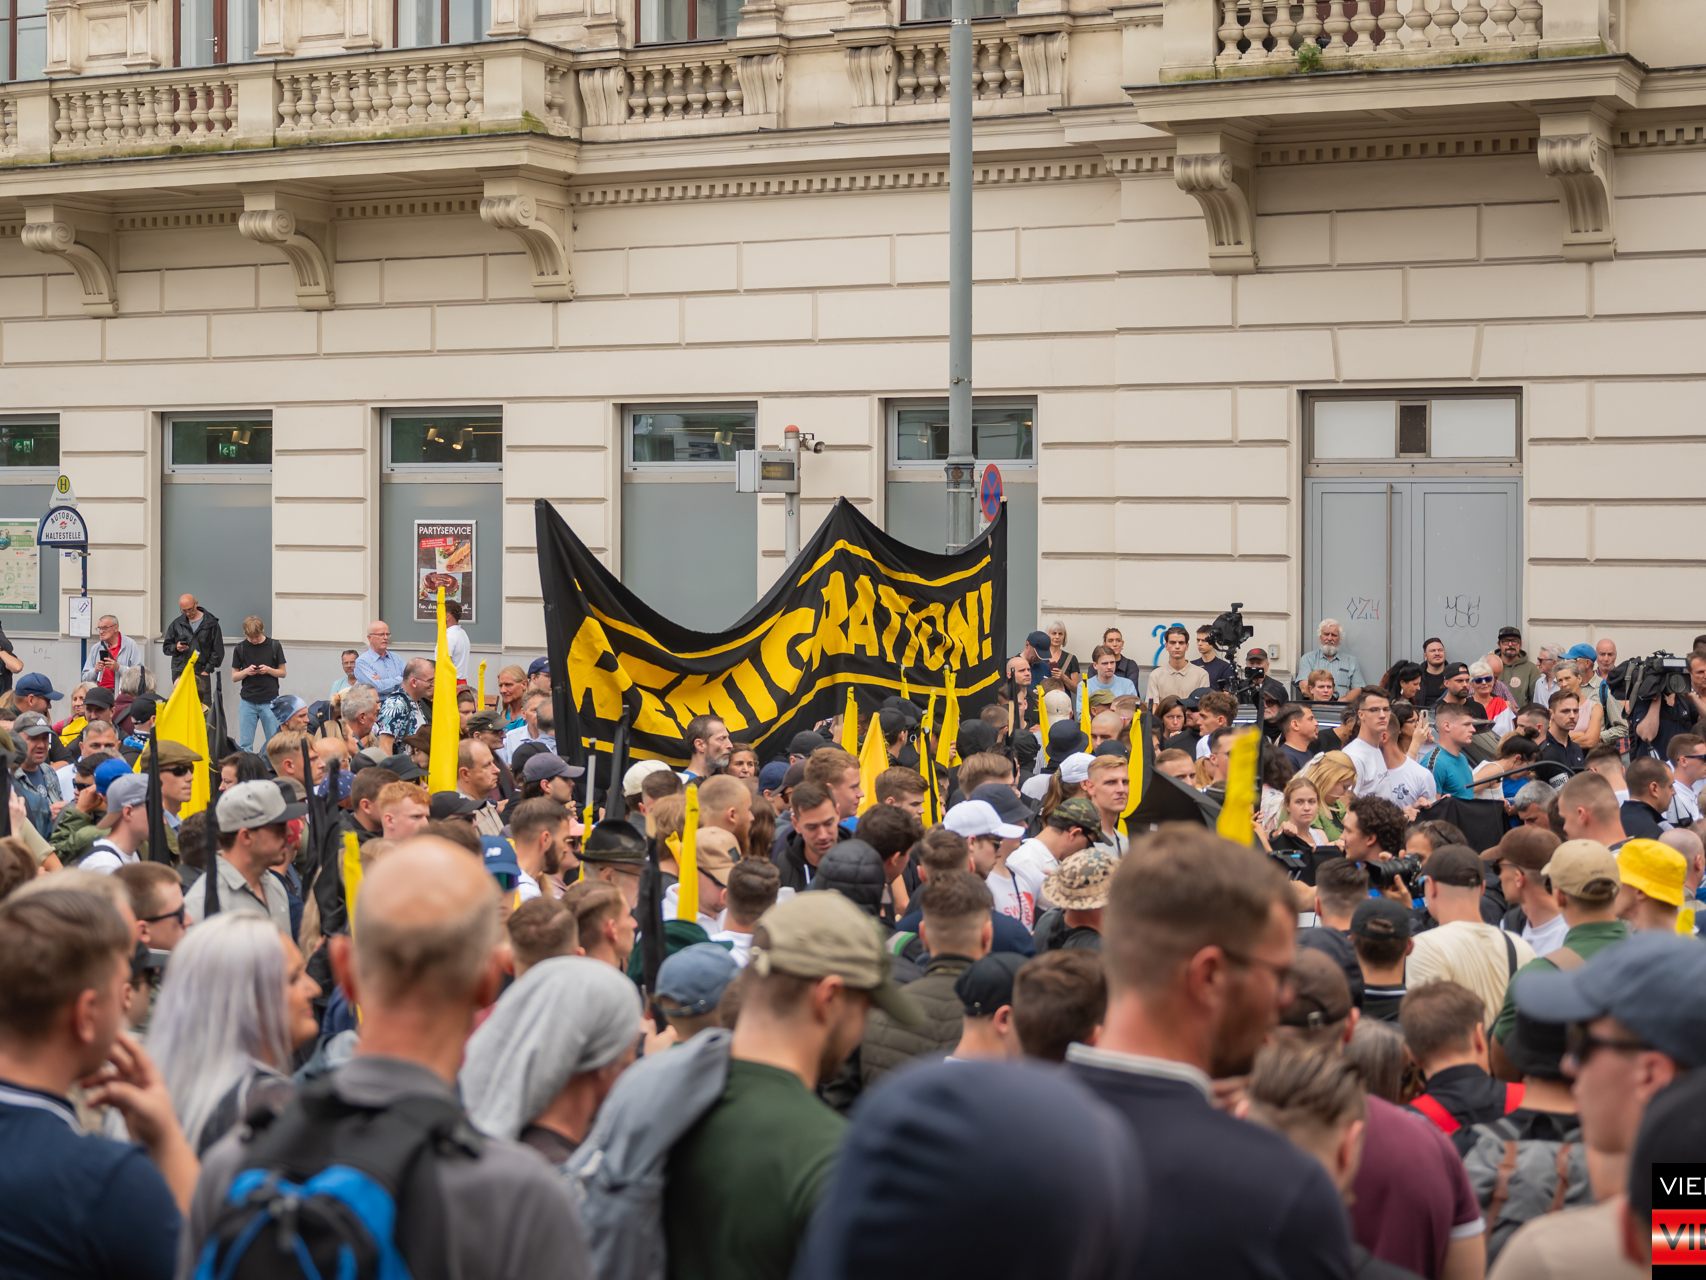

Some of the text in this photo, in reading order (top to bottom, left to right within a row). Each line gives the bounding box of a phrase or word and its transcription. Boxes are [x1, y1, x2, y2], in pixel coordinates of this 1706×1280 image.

[60, 479, 67, 490] H
[50, 511, 78, 525] AUTOBUS
[45, 531, 81, 540] HALTESTELLE
[418, 526, 472, 535] PARTYSERVICE
[567, 570, 993, 740] REMIGRATION!
